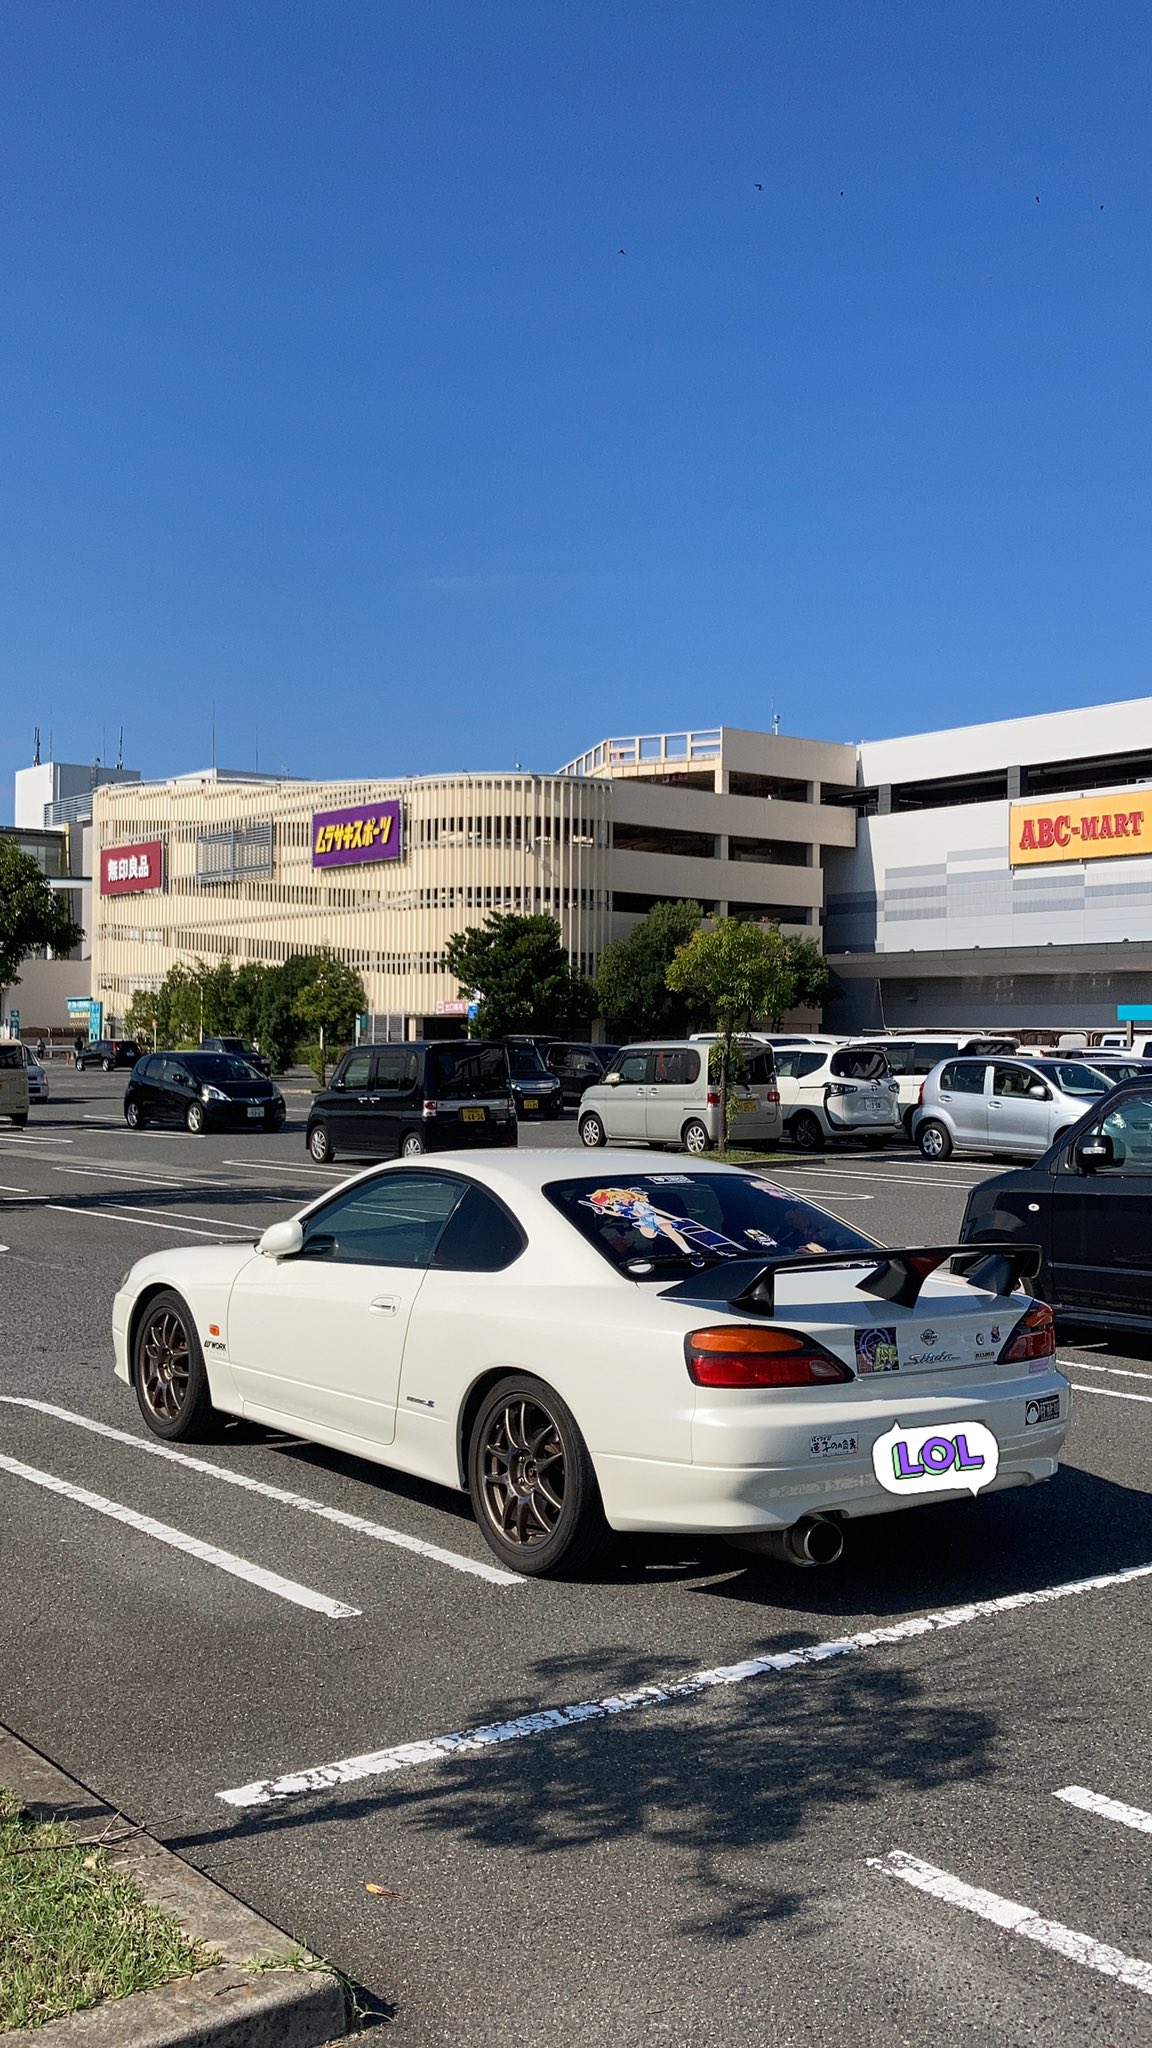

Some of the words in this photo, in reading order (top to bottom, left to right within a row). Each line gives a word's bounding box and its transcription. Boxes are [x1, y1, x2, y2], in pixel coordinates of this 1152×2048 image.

[315, 815, 393, 854] ムラサキスポーツ
[1019, 811, 1145, 850] ABC-MART
[107, 854, 150, 882] 無印良品
